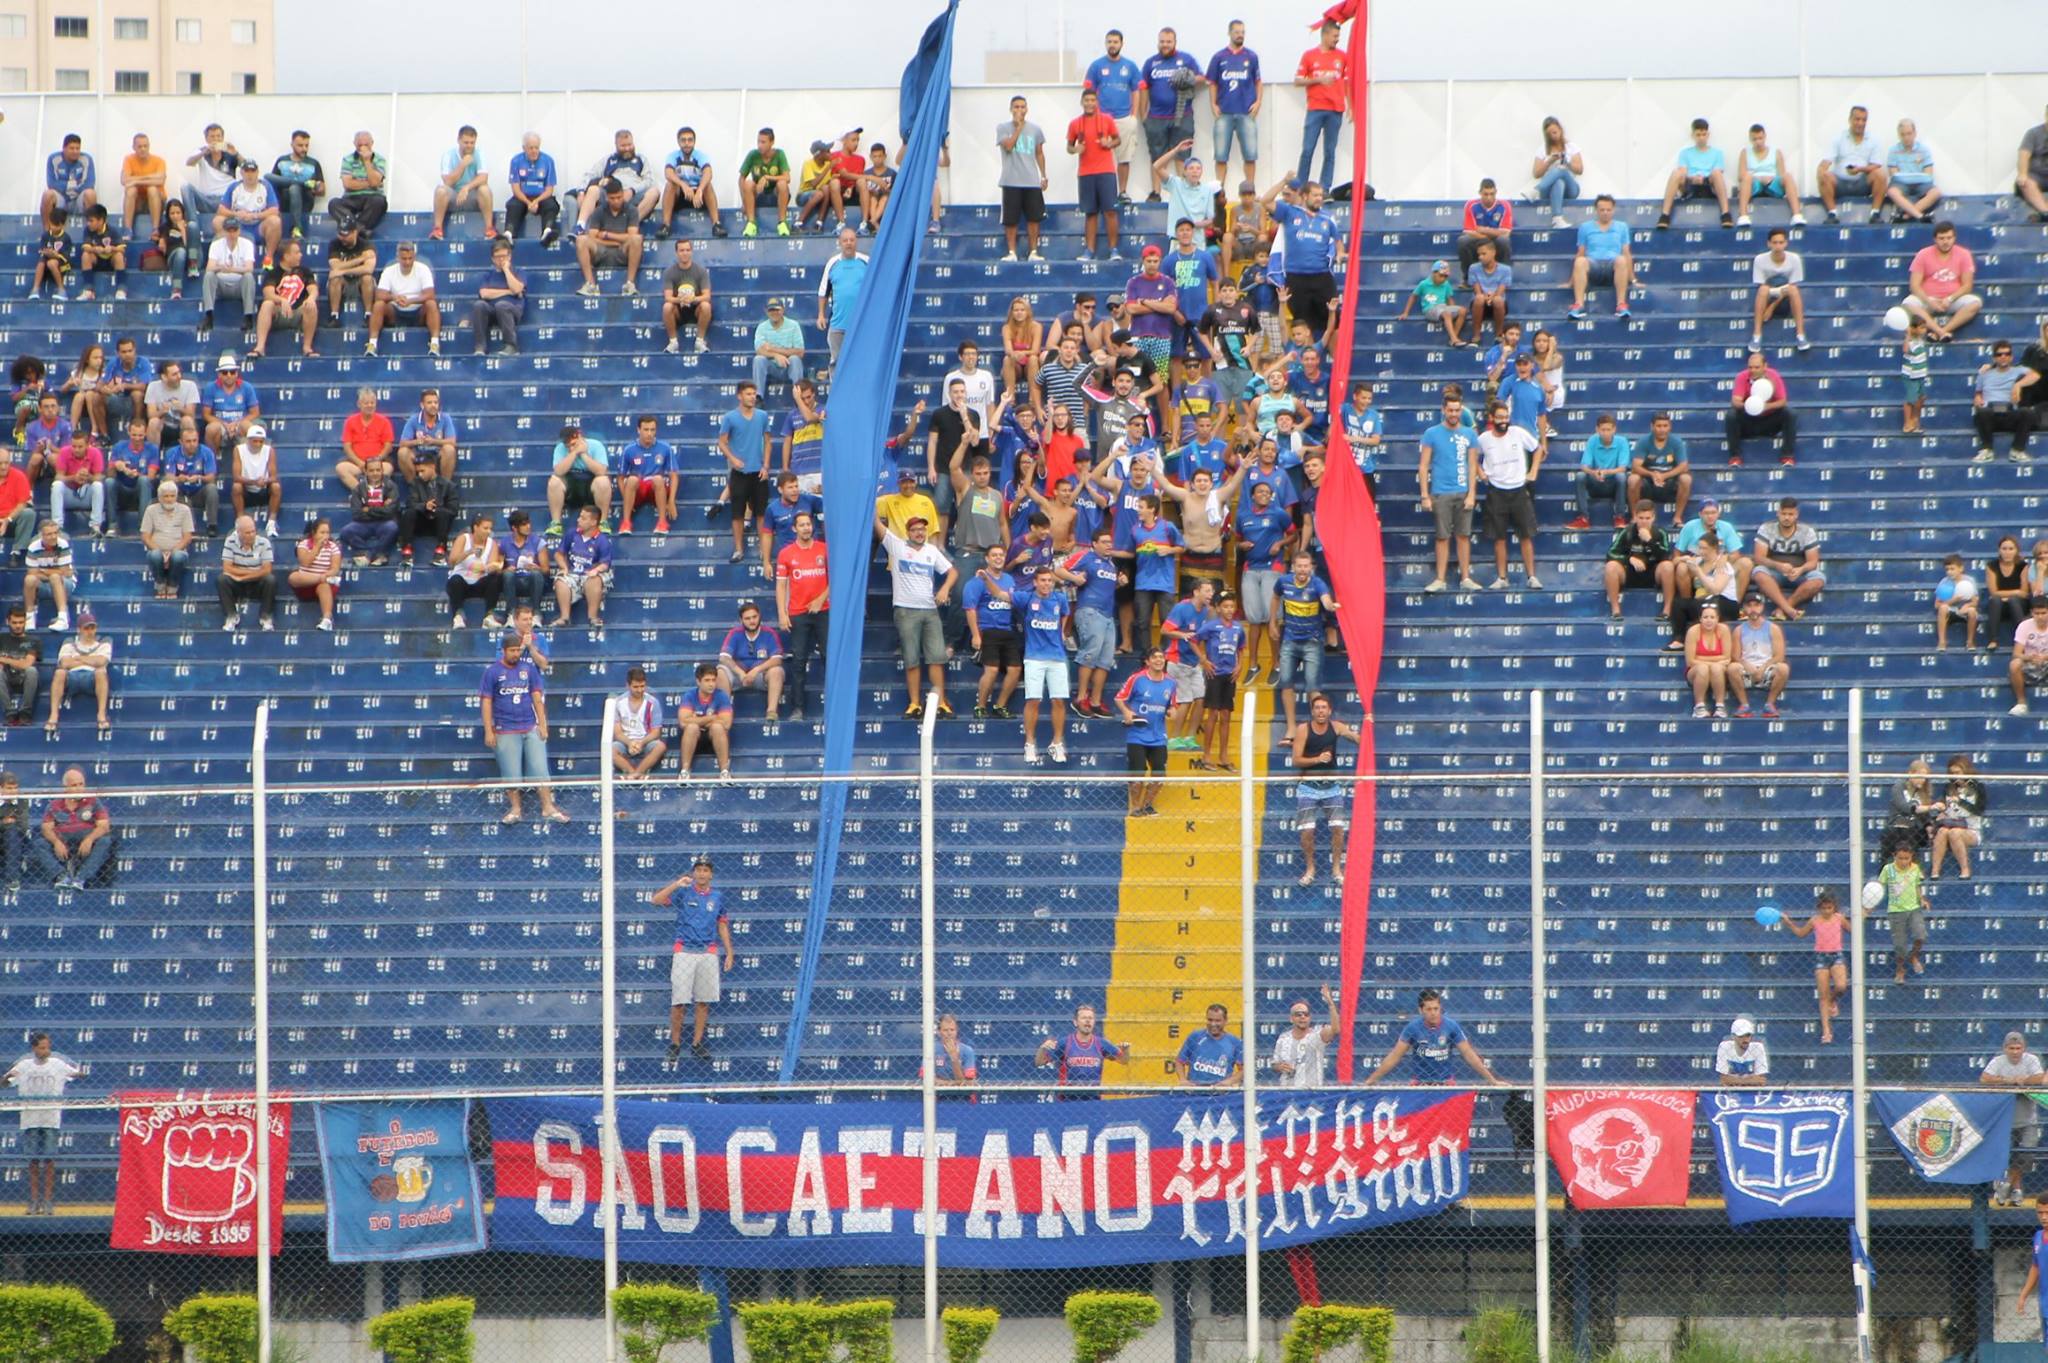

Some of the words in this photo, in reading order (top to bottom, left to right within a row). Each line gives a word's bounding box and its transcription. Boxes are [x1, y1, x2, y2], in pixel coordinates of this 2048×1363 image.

[1221, 69, 1249, 81] Consul
[1229, 80, 1238, 92] 9
[1839, 228, 1851, 240] 11
[16, 245, 28, 255] 11
[306, 244, 320, 255] 17
[449, 243, 465, 253] 20
[1682, 261, 1700, 272] 08
[645, 270, 662, 280] 24
[789, 267, 806, 278] 27
[1884, 286, 1900, 296] 12
[1986, 286, 2002, 296] 14
[538, 298, 555, 309] 22
[730, 296, 747, 308] 26
[1678, 320, 1697, 330] 08
[47, 332, 62, 343] 12
[146, 332, 161, 344] 14
[1777, 347, 1794, 358] 10
[1878, 347, 1895, 358] 12
[632, 356, 650, 368] 24
[731, 355, 749, 367] 26
[928, 354, 946, 365] 30
[387, 360, 401, 371] 19
[279, 389, 294, 400] 17
[614, 415, 631, 426] 24
[1227, 413, 1236, 425] X
[1872, 437, 1888, 448] 12
[908, 445, 923, 455] 30
[1768, 470, 1785, 480] 10
[2016, 466, 2033, 477] 15
[310, 479, 324, 490] 18
[1870, 530, 1887, 541] 12
[1969, 528, 1987, 540] 14
[698, 566, 715, 577] 26
[1404, 596, 1423, 606] 03
[1504, 593, 1523, 604] 05
[1913, 590, 1929, 601] 13
[384, 602, 402, 613] 20
[691, 630, 708, 641] 26
[1605, 625, 1625, 636] 07
[1813, 625, 1825, 636] 11
[127, 634, 142, 646] 15
[232, 634, 248, 645] 17
[334, 635, 349, 646] 19
[587, 631, 606, 642] 24
[1450, 658, 1470, 668] 04
[1554, 657, 1575, 668] 06
[1658, 657, 1677, 668] 08
[1869, 656, 1885, 667] 12
[1972, 655, 1989, 666] 14
[512, 694, 522, 705] 6
[873, 691, 891, 702] 30
[1397, 692, 1416, 703] 03
[1607, 690, 1628, 701] 07
[1821, 689, 1835, 700] 11
[211, 699, 227, 710] 17
[362, 697, 381, 708] 20
[1071, 723, 1088, 733] 34
[1501, 722, 1521, 733] 05
[1768, 721, 1785, 733] 10
[1878, 720, 1895, 731] 12
[149, 730, 166, 741] 16
[306, 728, 322, 740] 19
[1388, 756, 1408, 767] 03
[1650, 756, 1670, 766] 08
[2026, 752, 2043, 763] 15
[94, 763, 110, 774] 15
[399, 761, 414, 772] 21
[1189, 758, 1204, 770] M
[1190, 788, 1201, 800] L
[1186, 821, 1196, 833] K
[1185, 856, 1195, 868] J
[1177, 922, 1189, 935] H
[1174, 956, 1186, 969] G
[1172, 990, 1184, 1004] F
[1168, 1025, 1180, 1039] E
[1164, 1060, 1176, 1074] D
[357, 1130, 439, 1153] FUTEBOL
[1737, 1118, 1831, 1189] 95
[533, 1114, 701, 1236] SÃO
[725, 1123, 1153, 1241] CAETANO
[368, 1215, 391, 1231] DO
[143, 1215, 203, 1245] Desde
[208, 1222, 252, 1244] 1995
